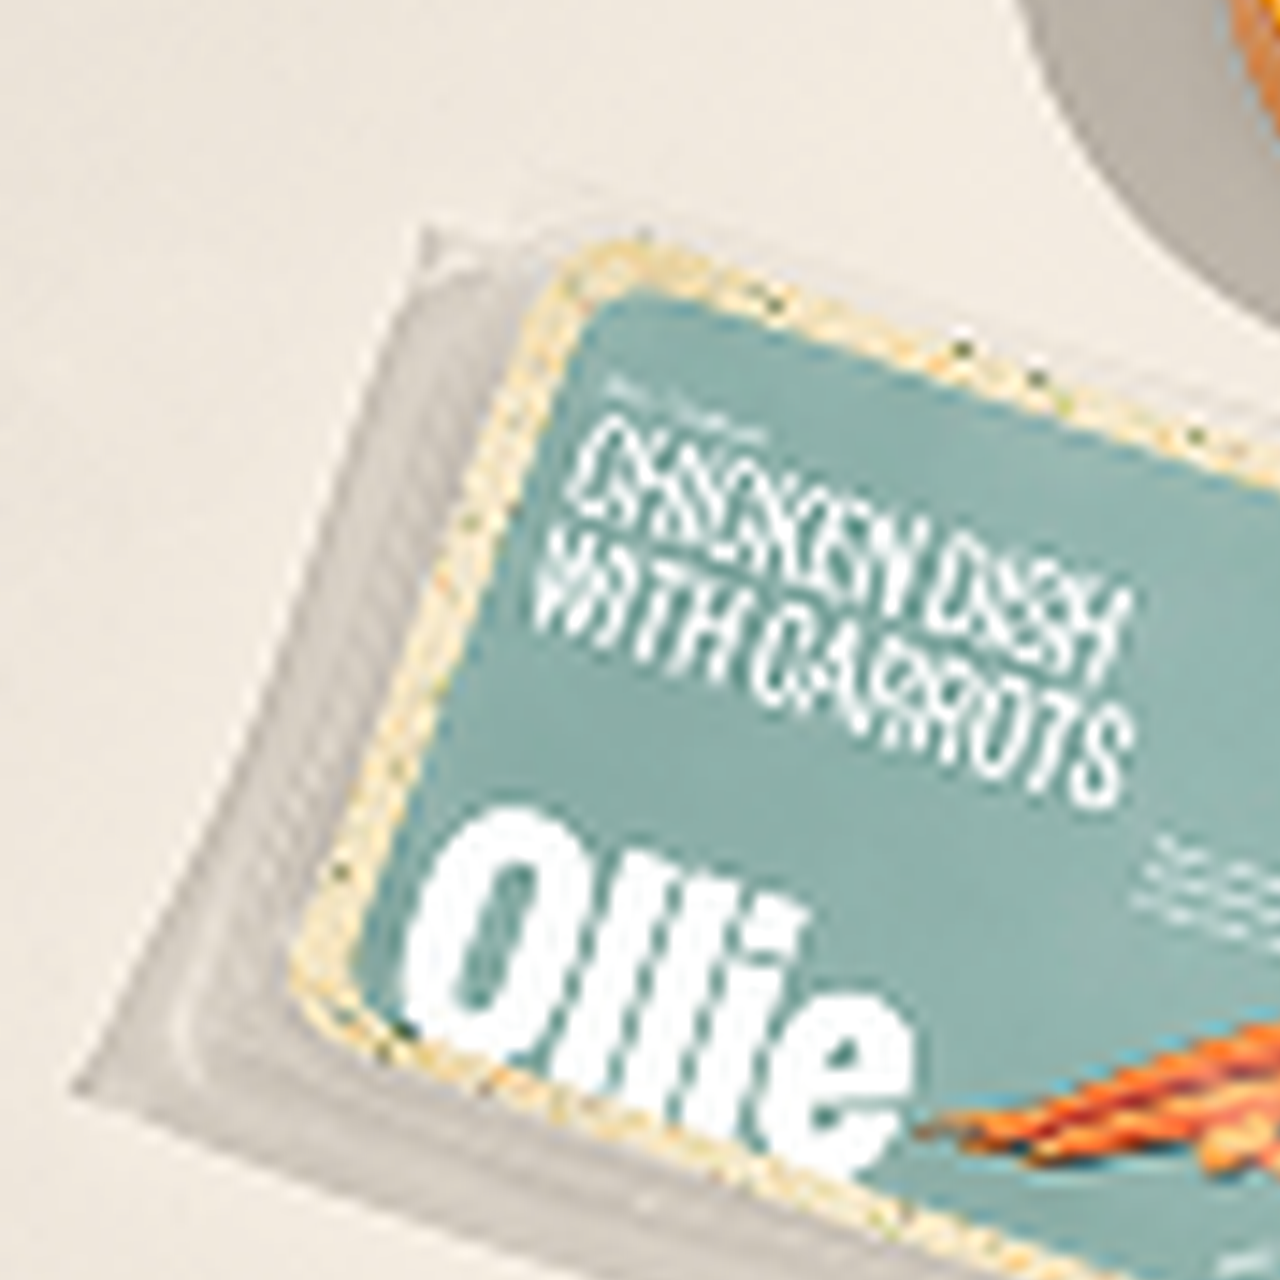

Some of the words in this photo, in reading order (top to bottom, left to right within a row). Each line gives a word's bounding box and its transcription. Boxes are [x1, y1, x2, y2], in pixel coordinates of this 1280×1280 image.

[535, 527, 755, 685] WITH
[752, 600, 1134, 809] CARROTS
[564, 412, 931, 619] CHICKEN
[925, 529, 1134, 690] DISH
[400, 805, 915, 1182] Ollie
